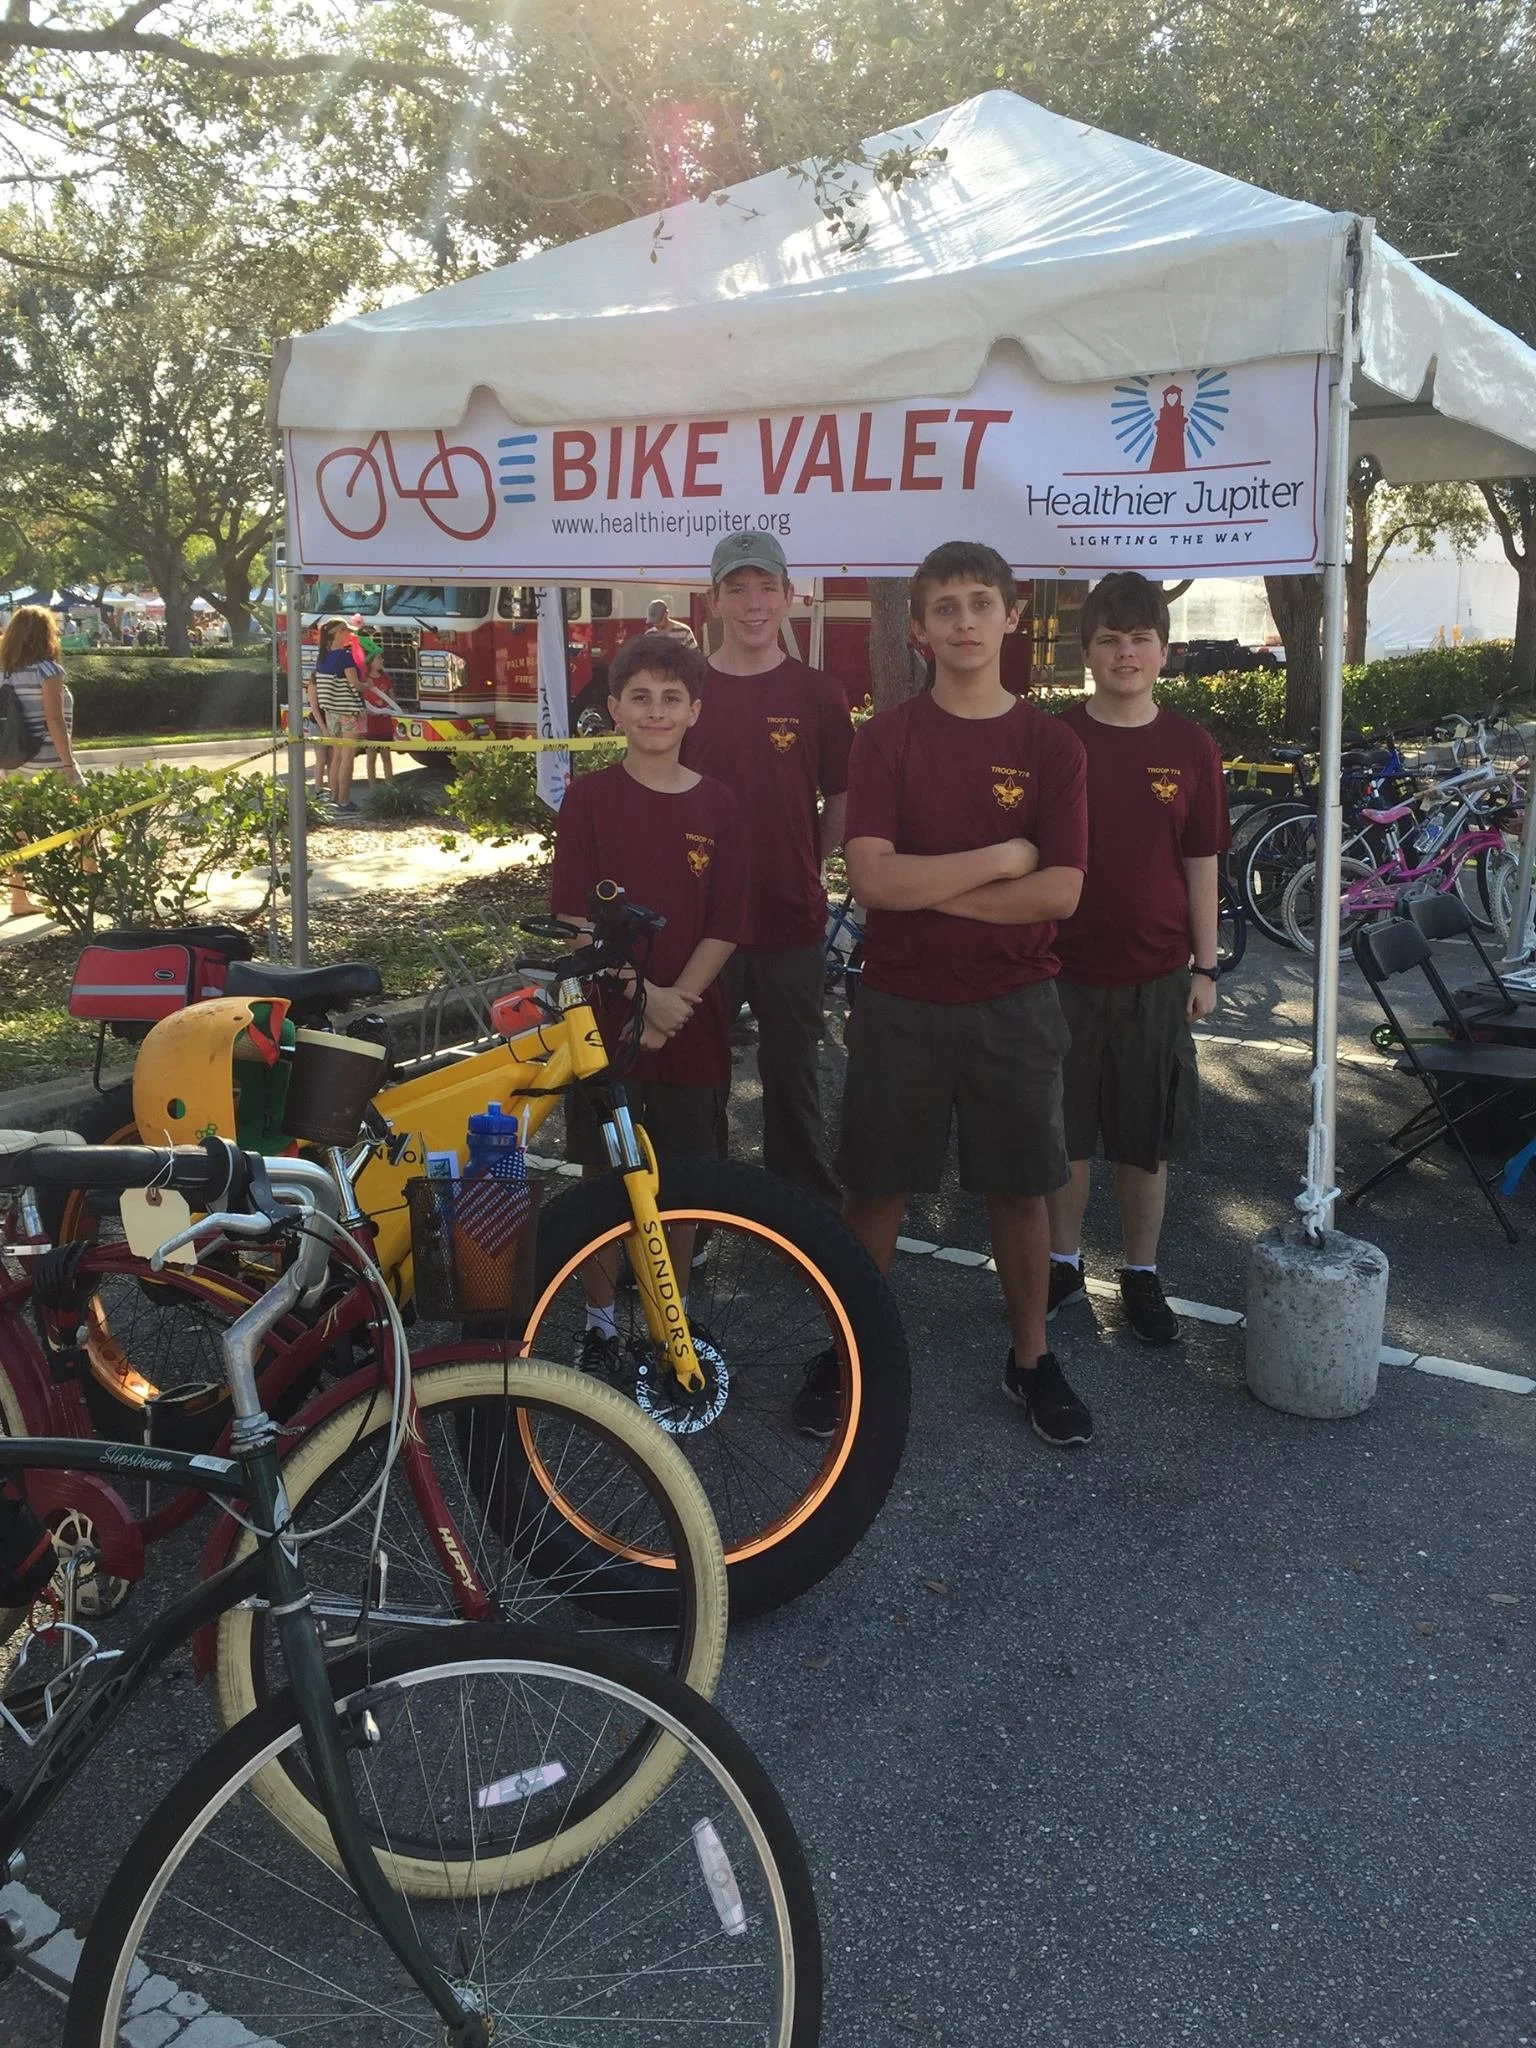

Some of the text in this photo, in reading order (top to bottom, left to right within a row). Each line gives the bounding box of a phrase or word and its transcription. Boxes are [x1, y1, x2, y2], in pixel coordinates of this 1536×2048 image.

[552, 408, 1014, 502] BIKE VALET
[1026, 476, 1304, 519] Healthier Jupiter
[552, 509, 792, 538] www.healthierjupiter.org
[1070, 531, 1253, 547] LIGHTING THE WAY
[766, 716, 788, 724] TROOP
[991, 765, 1017, 776] TROOP
[684, 832, 707, 843] TROOP
[643, 1220, 690, 1358] SONDORS
[99, 1446, 173, 1472] Slipstream
[437, 1527, 478, 1592] HUFFY
